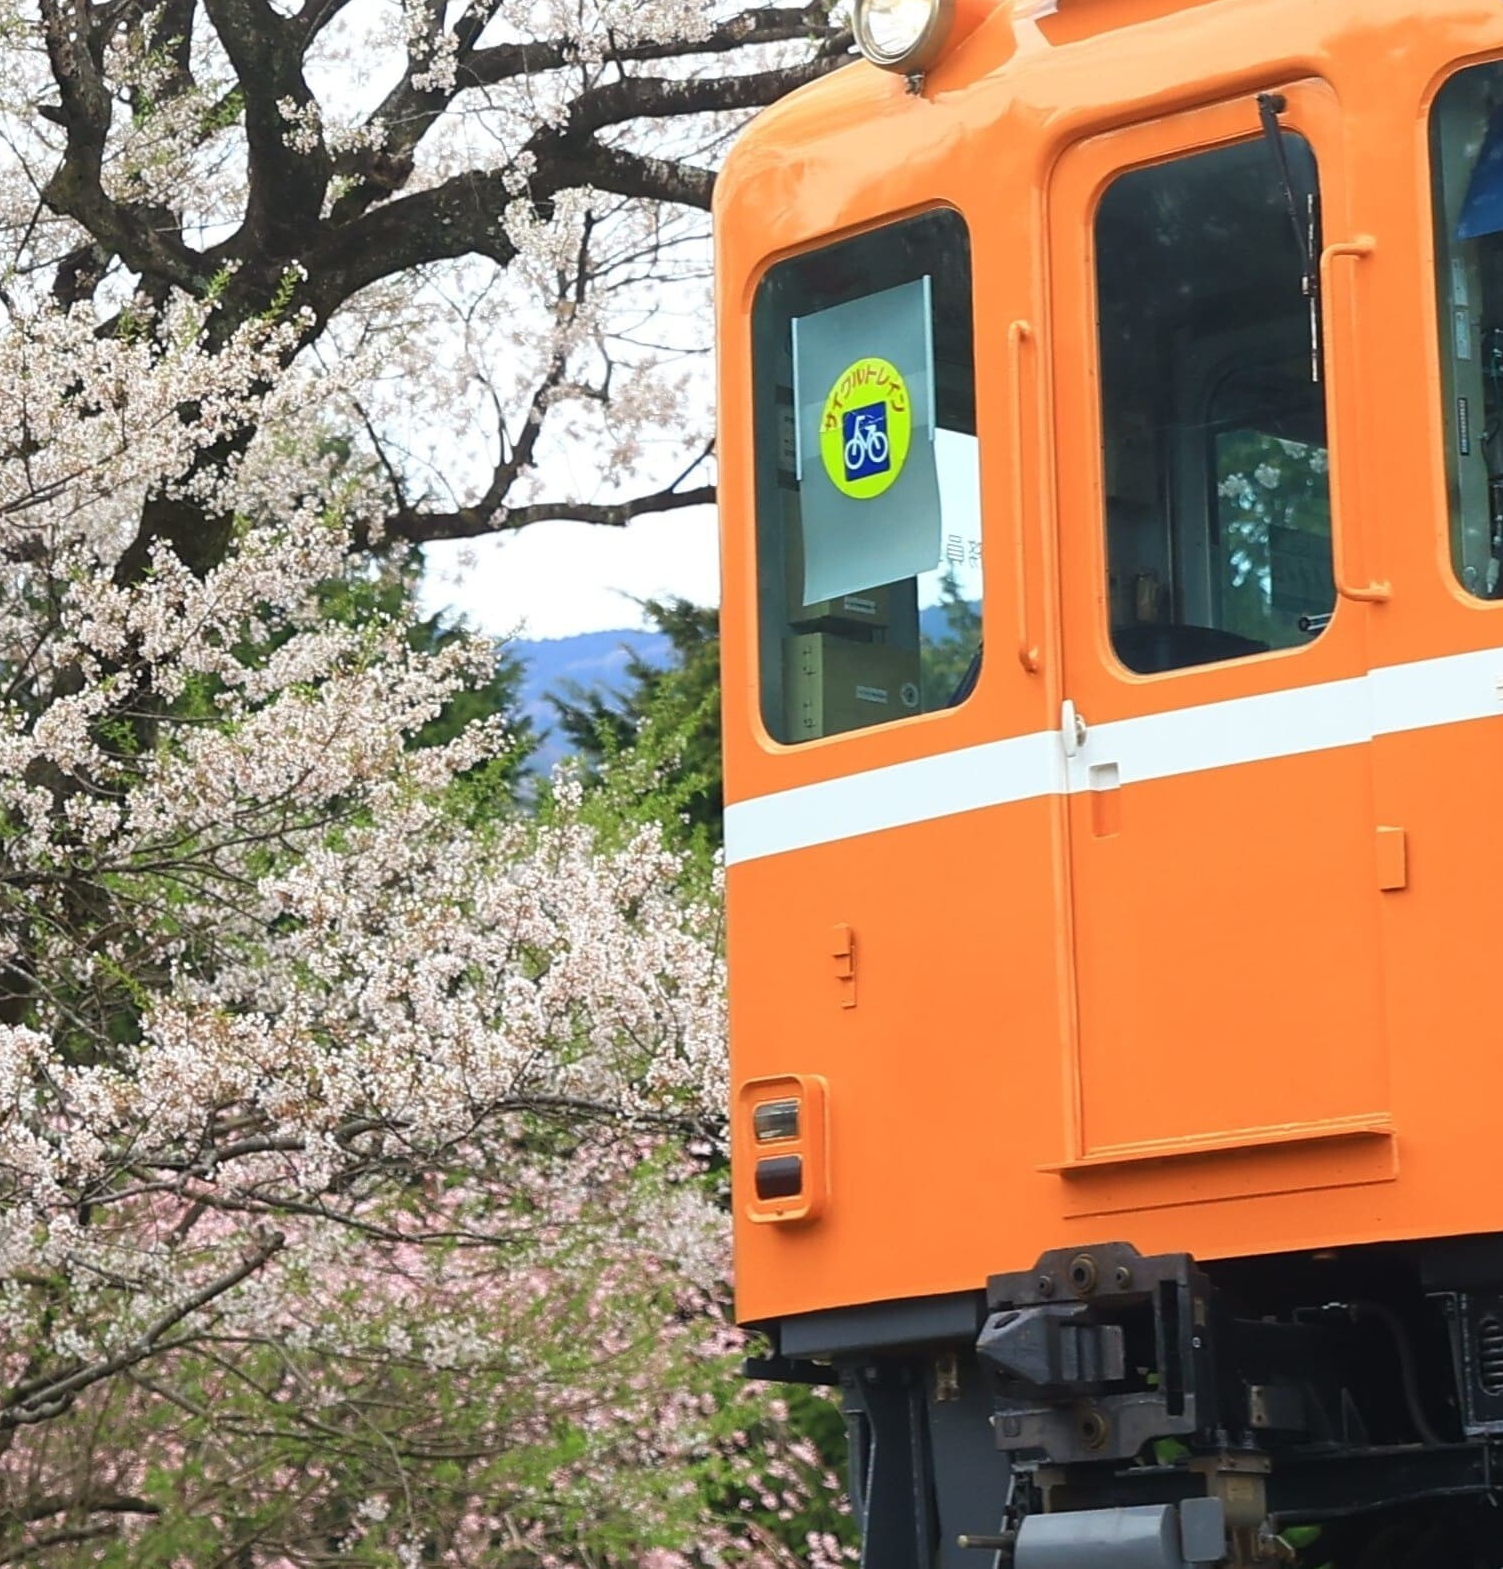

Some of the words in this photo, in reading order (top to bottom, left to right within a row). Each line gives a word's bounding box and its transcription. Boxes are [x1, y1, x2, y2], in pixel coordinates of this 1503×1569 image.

[825, 364, 905, 430] サイクルトレイン
